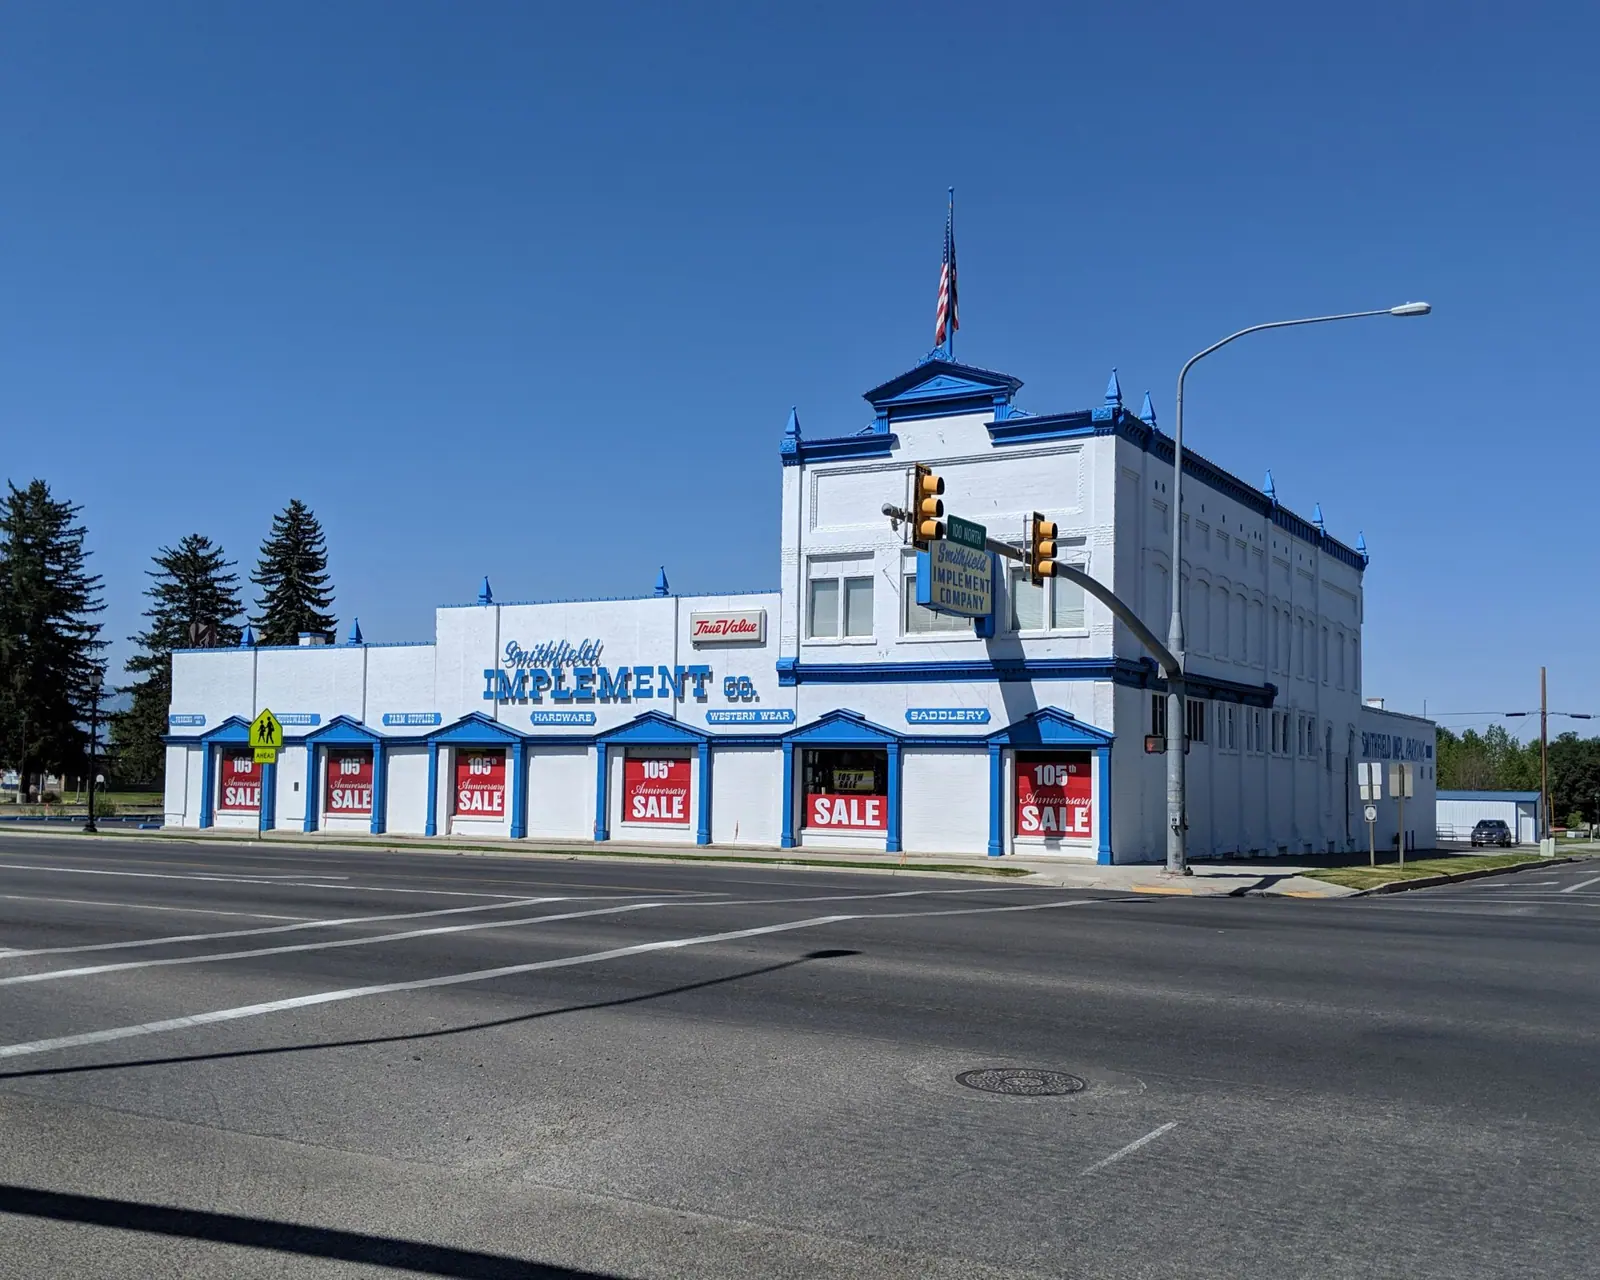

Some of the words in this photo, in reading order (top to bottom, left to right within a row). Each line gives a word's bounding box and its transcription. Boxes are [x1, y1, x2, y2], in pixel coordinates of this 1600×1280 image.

[953, 523, 963, 538] 100
[964, 526, 982, 545] NORTH
[938, 541, 987, 573] Smithfield
[934, 566, 990, 594] IMPLEMENT
[940, 587, 985, 611] COMPANY
[501, 638, 601, 668] Smithfield
[483, 665, 710, 700] IMPLEMENT
[723, 675, 757, 697] CO.
[389, 714, 406, 724] FARM
[534, 713, 592, 722] HARDWARE
[710, 711, 756, 721] WESTERN
[760, 710, 790, 720] WEAR
[910, 711, 985, 720] SADDLERY
[458, 778, 504, 796] Anniversary
[631, 781, 687, 804] Anniversary
[839, 780, 858, 789] SALE
[225, 787, 261, 806] SALE
[332, 789, 371, 809] SALE
[459, 790, 502, 811] SALE
[632, 795, 684, 819] SALE
[1020, 790, 1092, 816] Anniversary
[814, 798, 881, 826] SALE
[1022, 805, 1090, 833] SALE
